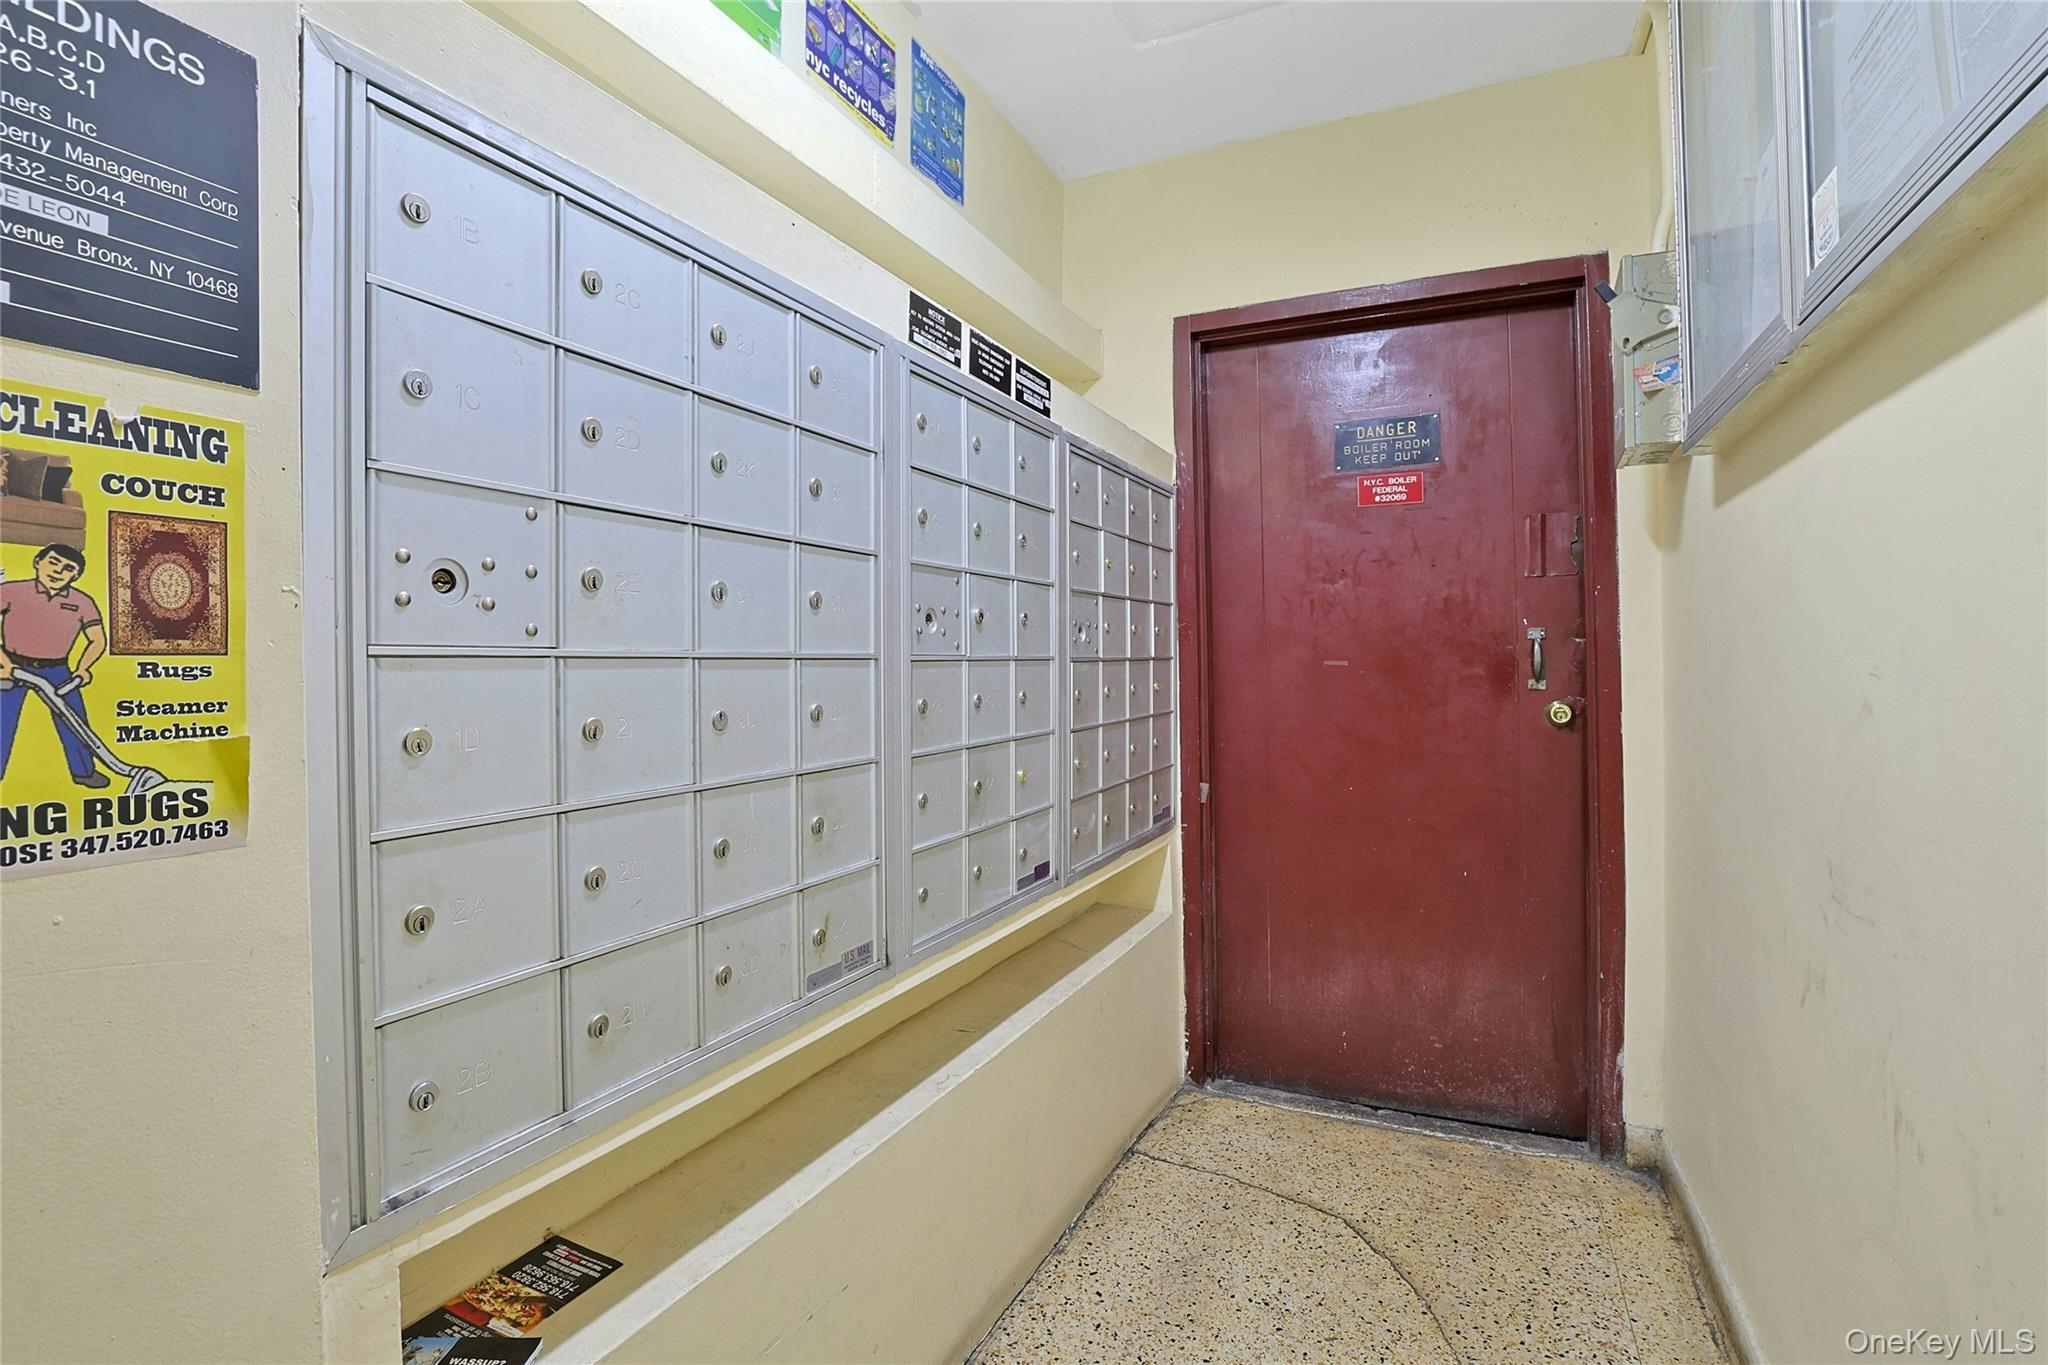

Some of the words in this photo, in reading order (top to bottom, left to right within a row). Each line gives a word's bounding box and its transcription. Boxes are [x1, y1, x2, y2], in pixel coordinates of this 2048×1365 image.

[10, 0, 206, 86] LDINGS
[806, 47, 831, 80] nyc
[833, 70, 886, 128] recycles
[0, 90, 51, 120] ners
[66, 111, 98, 137] Inc
[0, 153, 126, 207] 432-5044
[65, 141, 188, 200] Management
[199, 191, 239, 217] Corp
[28, 195, 91, 228] LEON
[0, 220, 64, 249] venue
[150, 259, 174, 281] NY
[187, 269, 239, 299] 10468
[0, 391, 229, 464] CLEANING
[1357, 420, 1417, 440] DANGER
[1344, 442, 1388, 455] BOILER
[1395, 438, 1431, 450] ROOM
[1355, 453, 1387, 464] KEEP
[1394, 450, 1418, 461] OUT
[100, 472, 226, 508] COUCH
[1372, 485, 1408, 494] FEDERAL
[1388, 475, 1417, 485] BOILER
[137, 661, 213, 681] Rugs
[116, 699, 229, 718] Steamer
[116, 722, 229, 743] Machine
[0, 802, 67, 840] NG
[83, 787, 209, 831] RUGS
[0, 841, 53, 868] OSE
[61, 820, 229, 859] 347.520.7463
